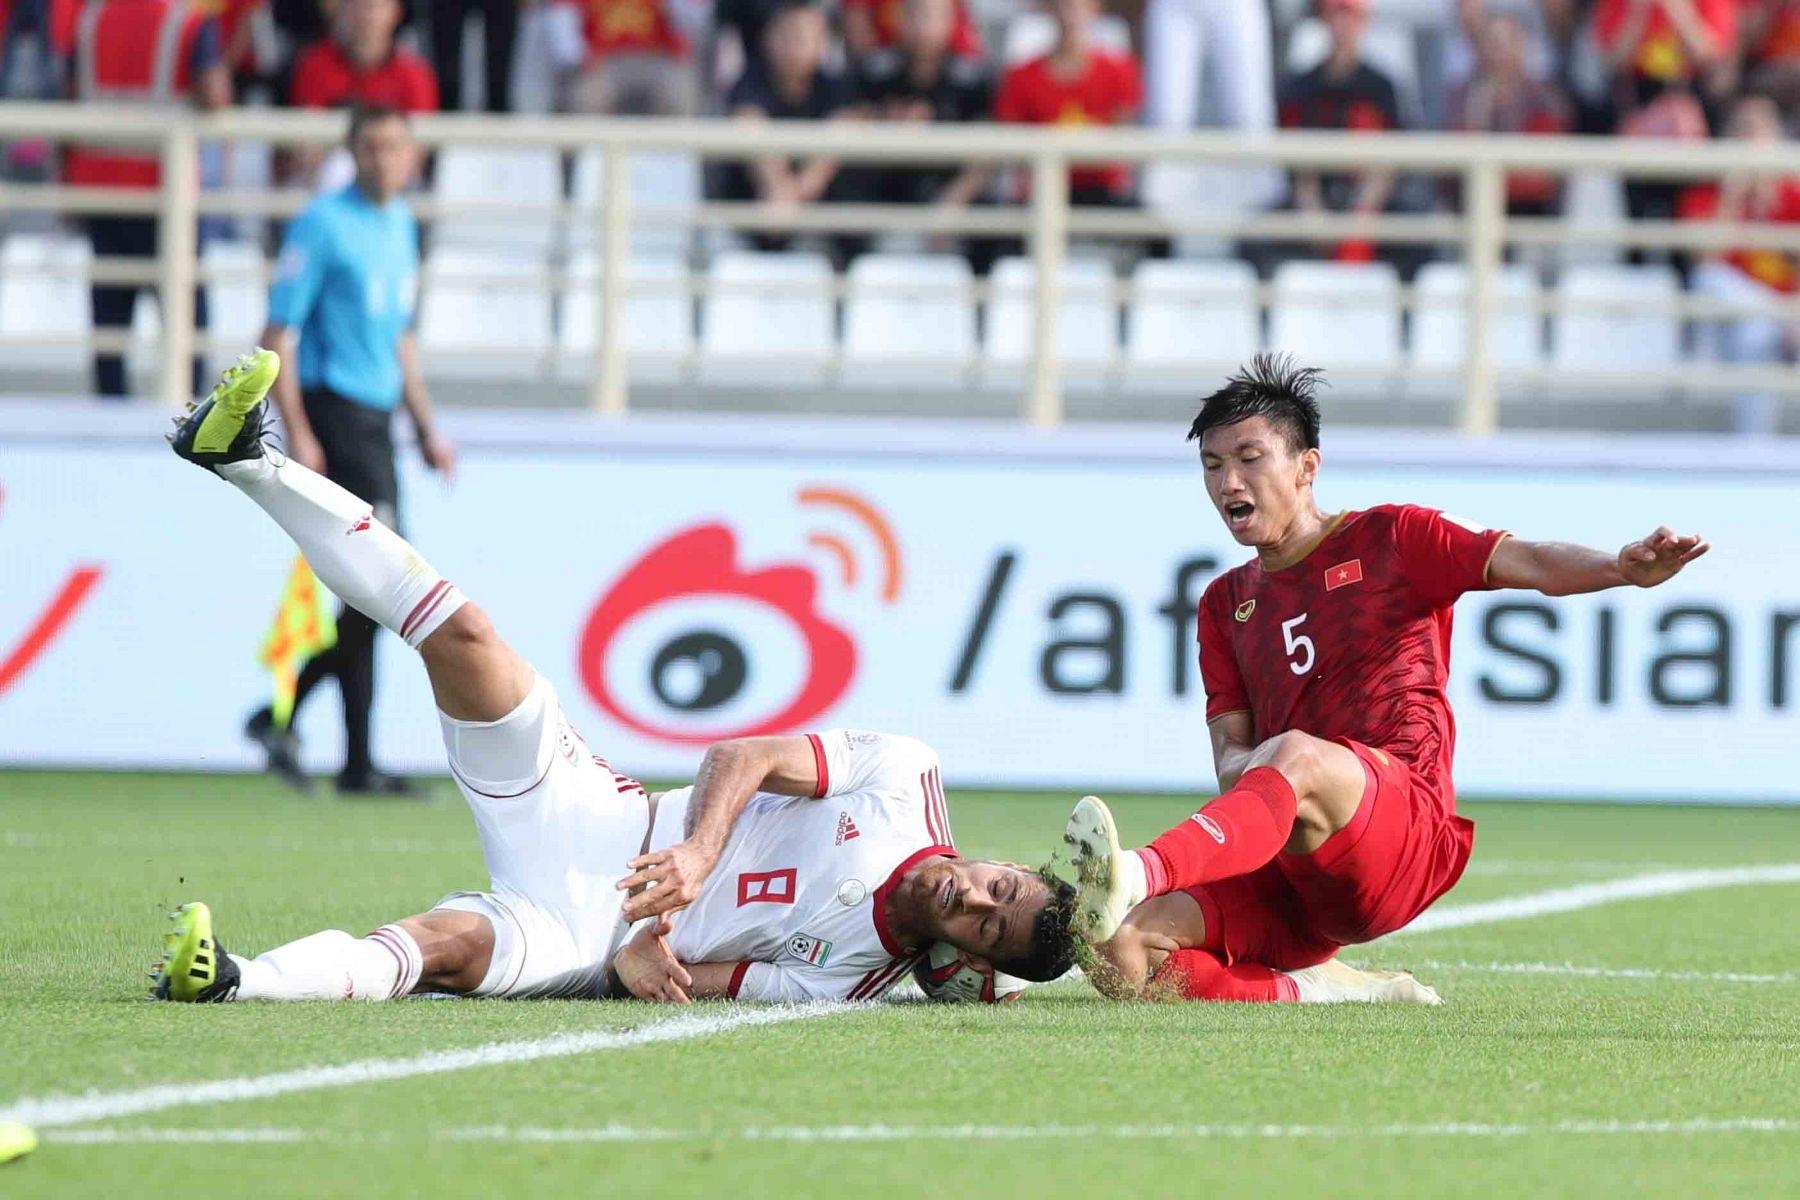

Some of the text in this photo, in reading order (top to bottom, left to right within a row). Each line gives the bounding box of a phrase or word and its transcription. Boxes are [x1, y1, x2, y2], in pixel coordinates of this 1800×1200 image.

[1282, 612, 1316, 676] 5
[835, 811, 847, 846] adidas
[737, 868, 797, 907] 8
